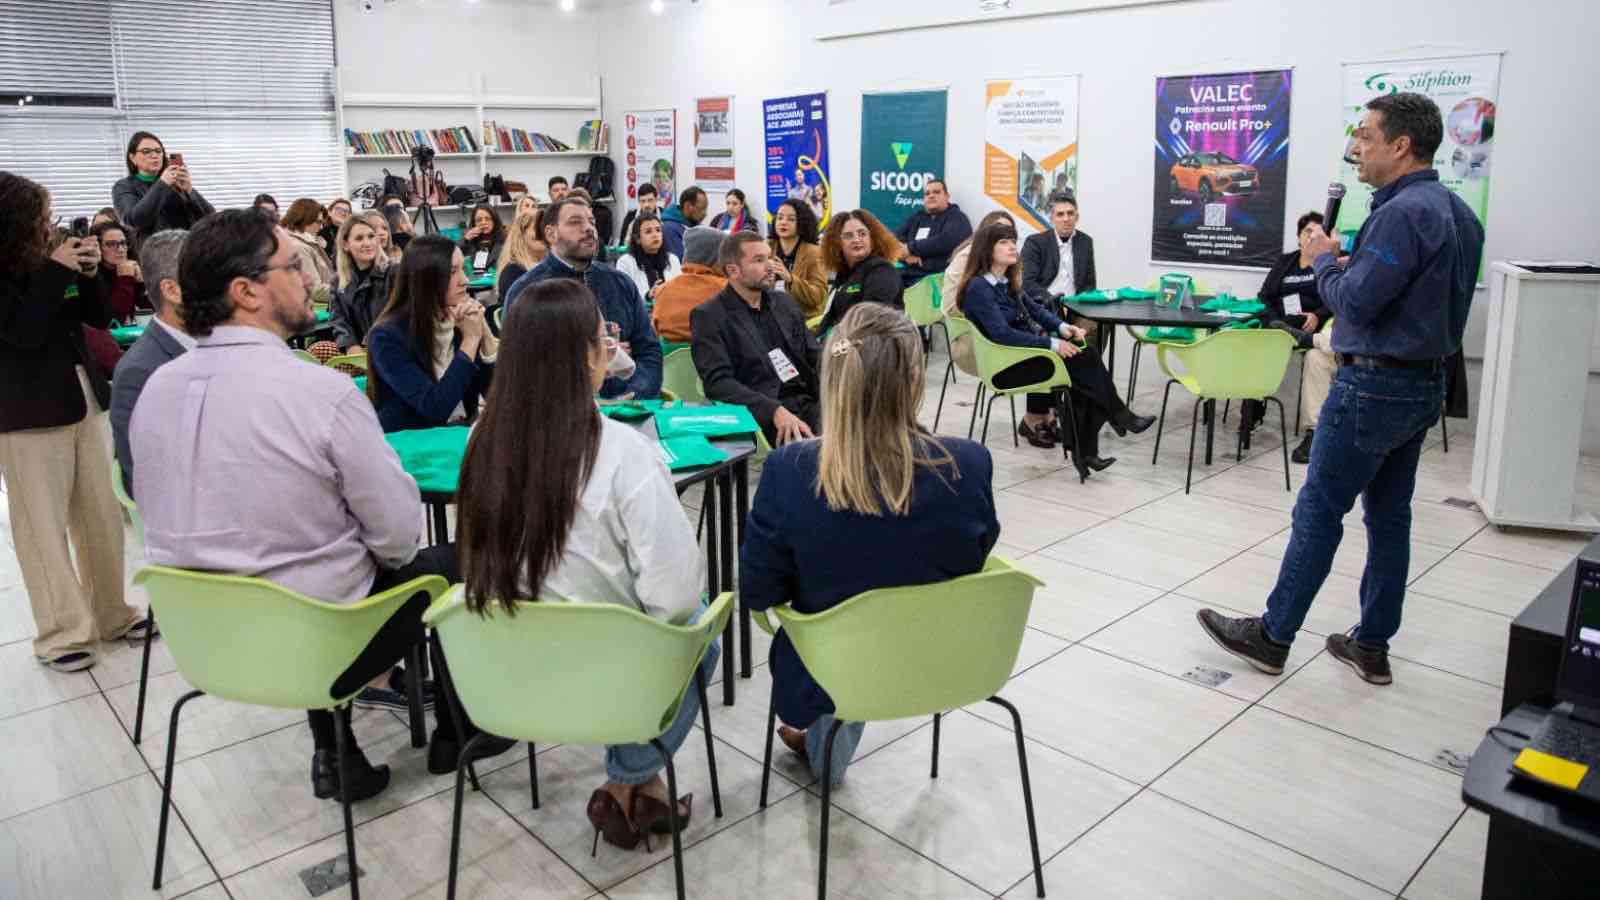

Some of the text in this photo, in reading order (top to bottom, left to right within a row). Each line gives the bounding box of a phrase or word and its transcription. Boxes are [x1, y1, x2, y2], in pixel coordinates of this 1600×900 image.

[1404, 70, 1472, 92] Silphion
[1190, 84, 1254, 104] VALEC
[1185, 118, 1273, 132] Renault Pro+
